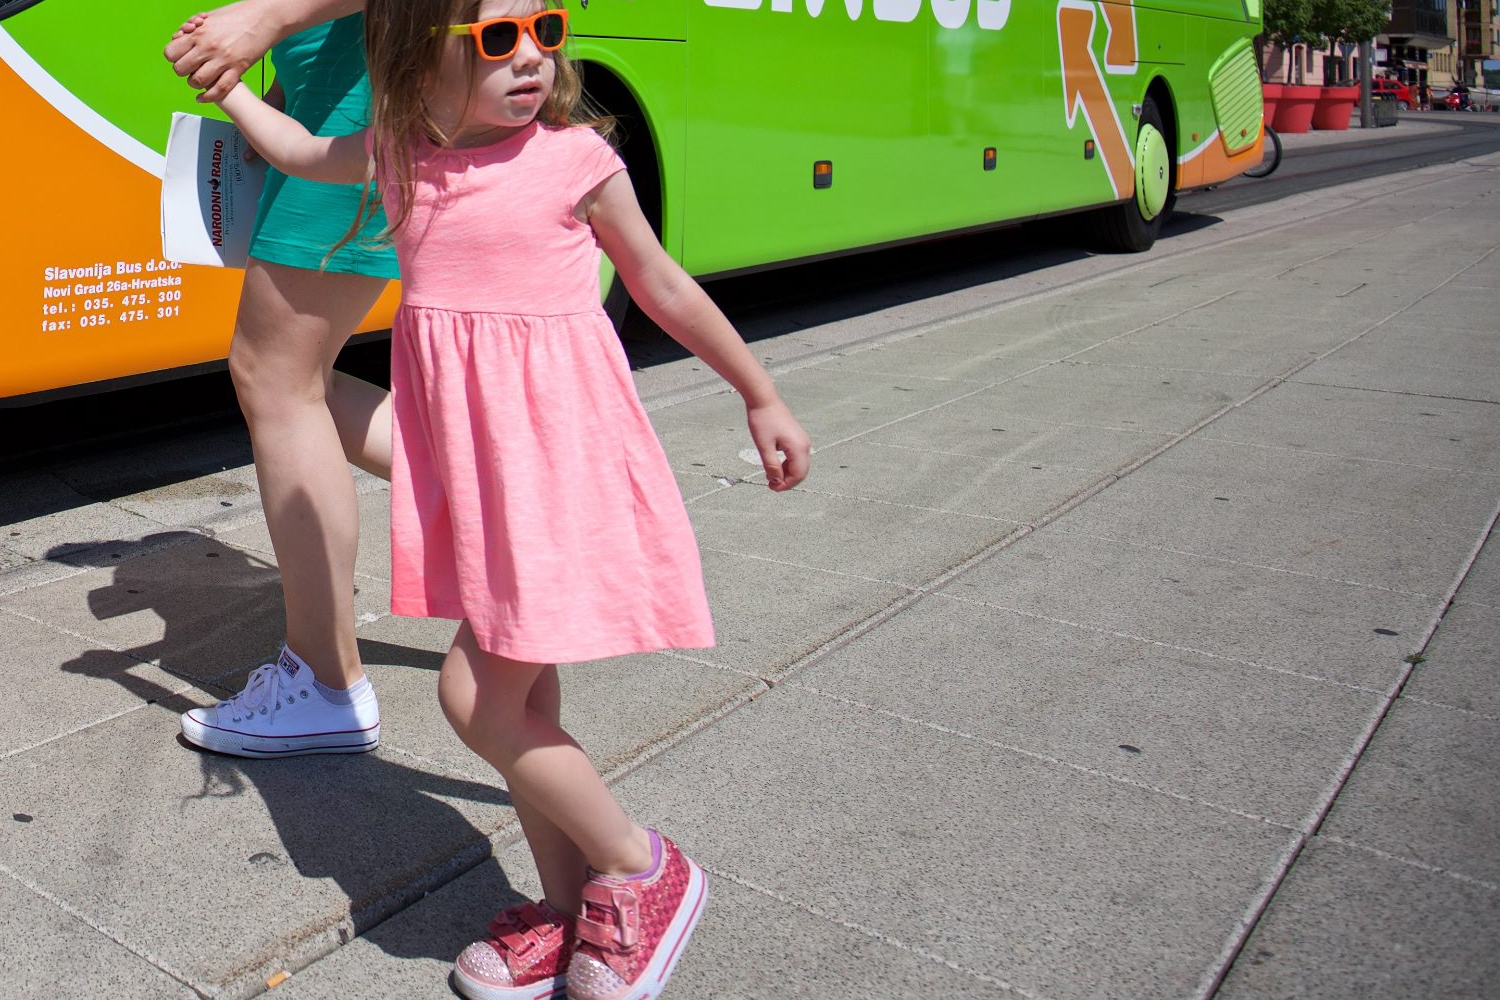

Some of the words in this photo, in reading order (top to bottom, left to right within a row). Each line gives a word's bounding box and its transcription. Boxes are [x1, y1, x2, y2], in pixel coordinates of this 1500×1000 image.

[211, 139, 224, 178] RADIO
[211, 191, 223, 247] NARODNI
[44, 263, 112, 281] Slavonija
[116, 261, 142, 275] Bus
[145, 259, 182, 272] d.o.o.
[43, 285, 71, 299] Novi
[74, 282, 104, 296] Grad
[106, 275, 182, 292] 26a-Hrvatska
[84, 298, 114, 310] 035.
[122, 294, 151, 306] 475.
[158, 290, 182, 303] 300
[42, 320, 71, 332] fax:
[80, 314, 111, 327] 035.
[119, 309, 149, 322] 475.
[156, 306, 180, 318] 301
